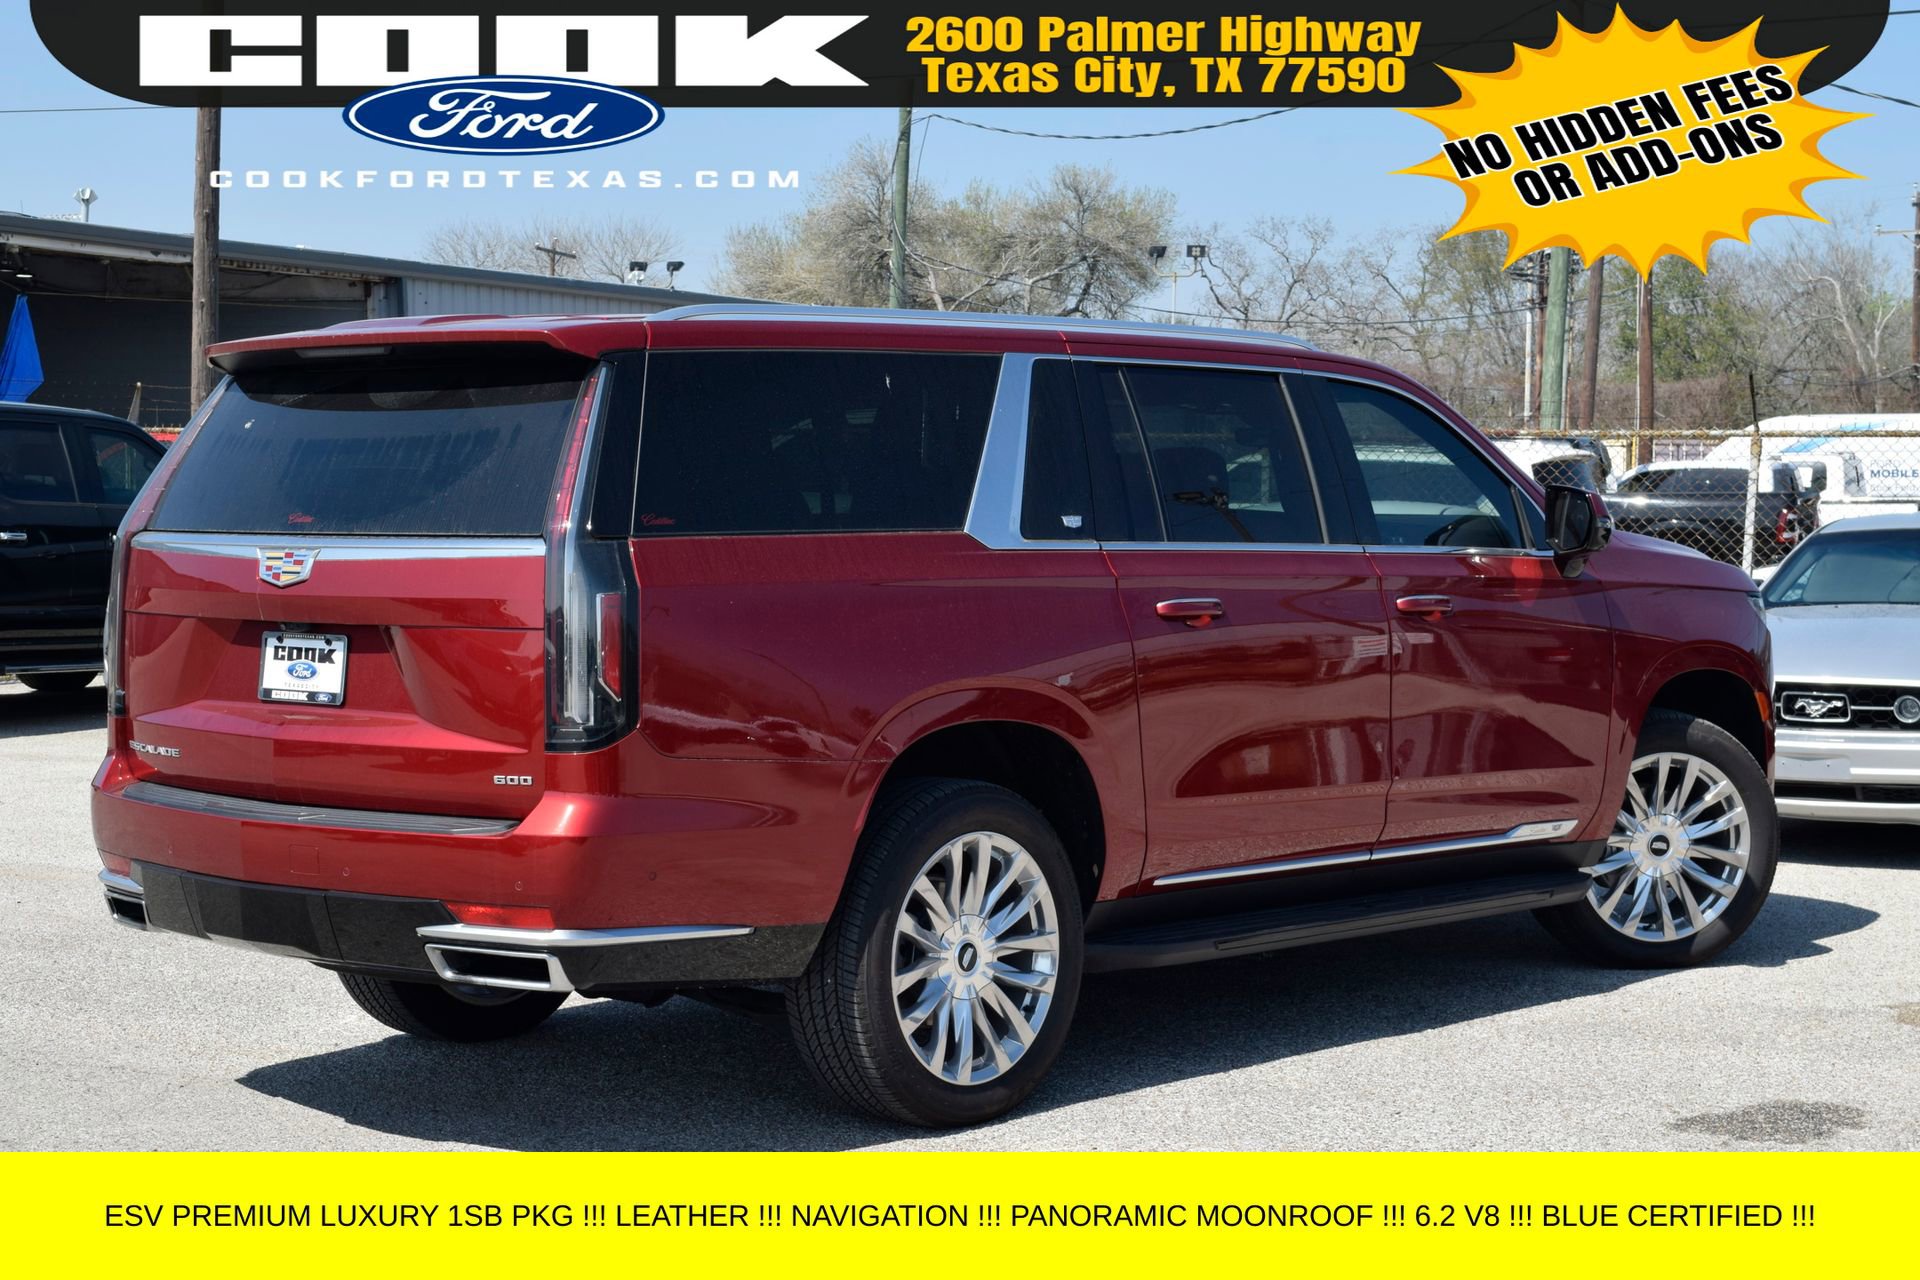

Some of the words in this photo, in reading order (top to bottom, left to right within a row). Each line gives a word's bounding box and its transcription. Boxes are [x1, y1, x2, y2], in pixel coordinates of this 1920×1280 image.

[1870, 469, 1919, 478] MOBILE
[273, 645, 337, 664] COOK
[129, 739, 181, 757] ESCALADE
[493, 775, 533, 785] 600
